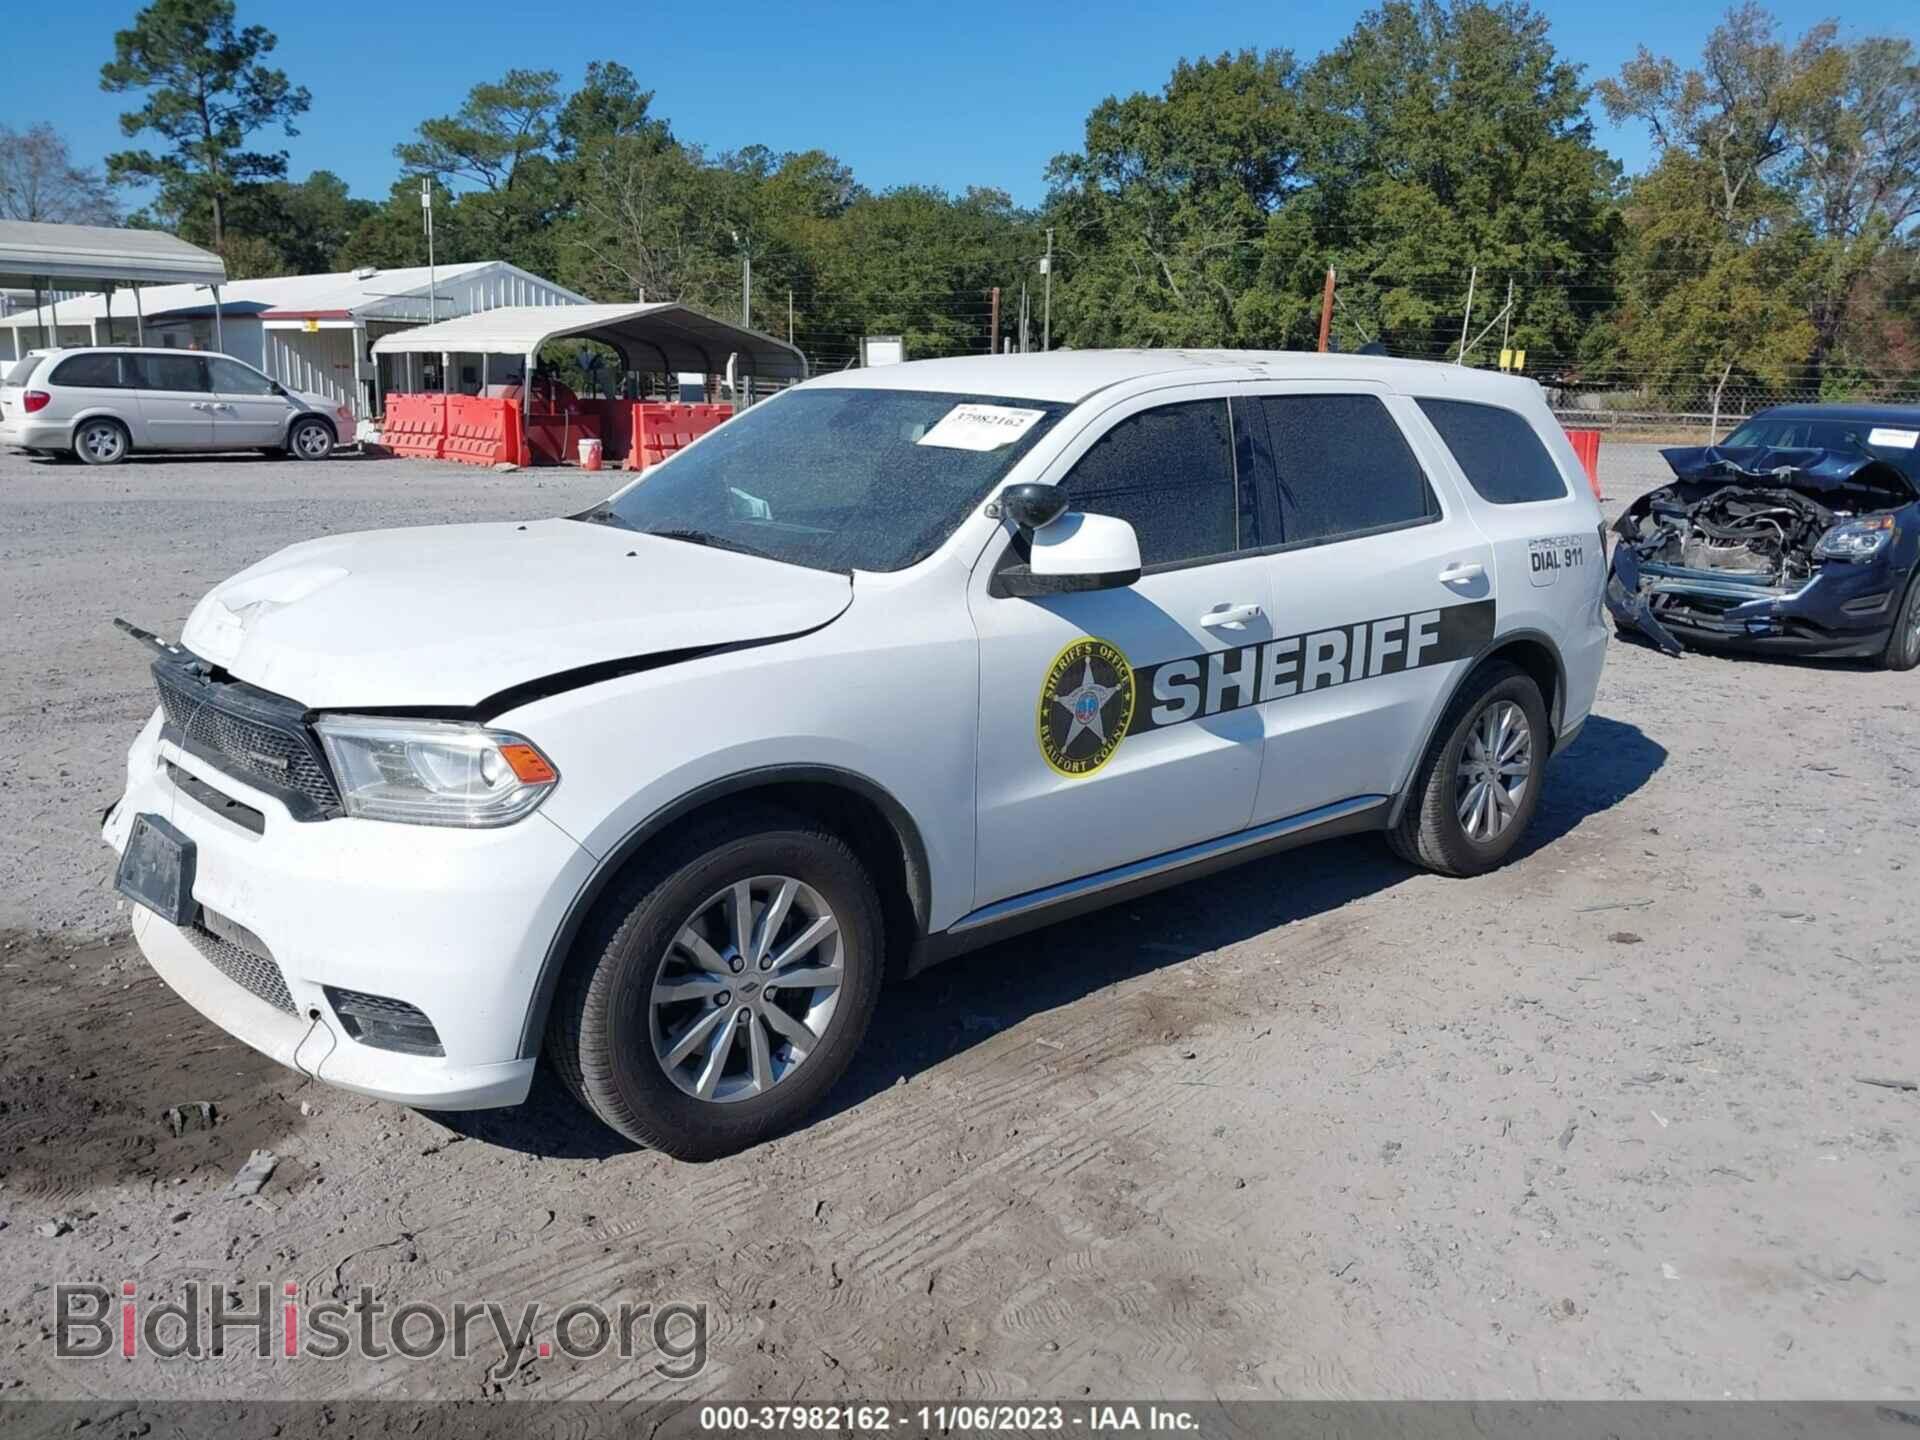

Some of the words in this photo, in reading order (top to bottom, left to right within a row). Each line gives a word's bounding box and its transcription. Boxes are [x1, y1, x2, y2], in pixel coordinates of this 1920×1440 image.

[1531, 550, 1561, 572] DIAL
[1564, 547, 1584, 568] 911
[1100, 645, 1130, 686] OFFICE
[1151, 610, 1441, 726] SHERIFF
